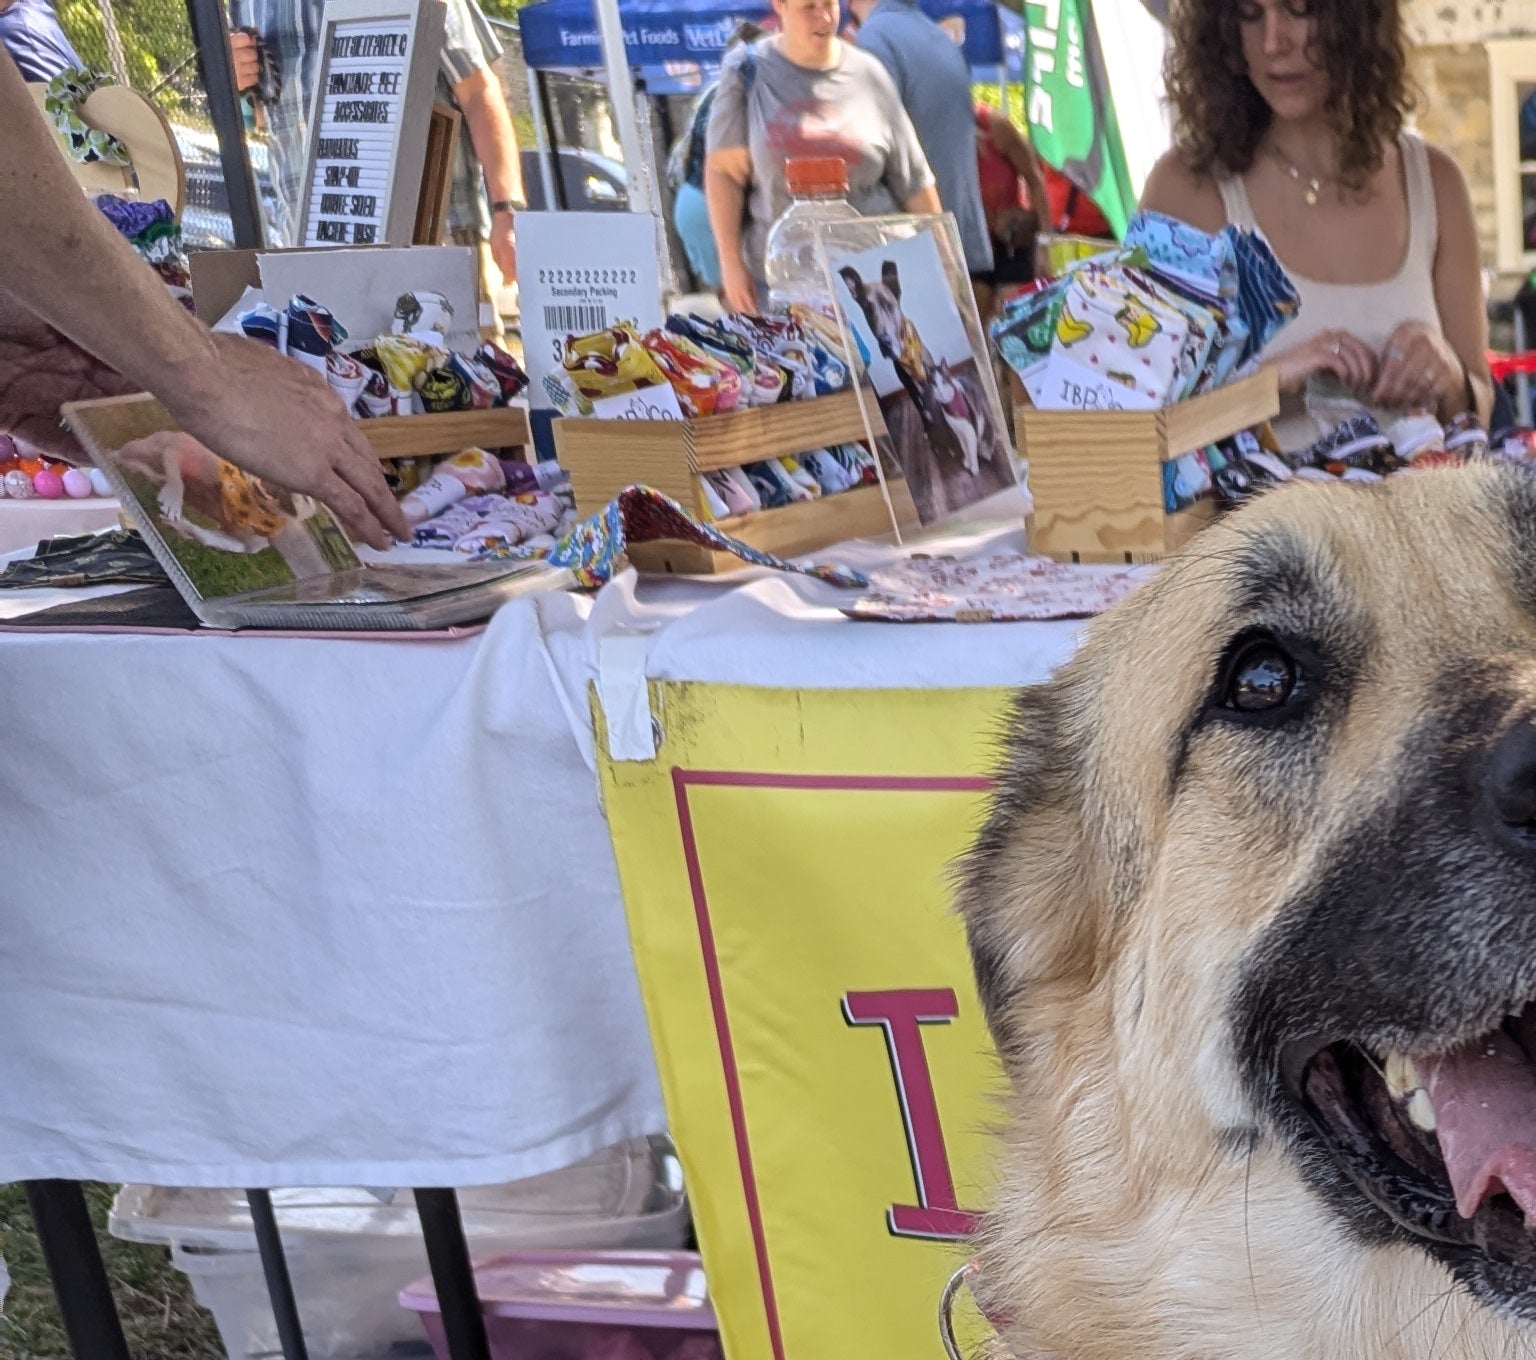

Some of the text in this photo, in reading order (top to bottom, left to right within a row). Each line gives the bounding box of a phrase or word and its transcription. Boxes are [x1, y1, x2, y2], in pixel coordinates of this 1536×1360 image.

[560, 30, 603, 47] Farmi
[640, 28, 680, 46] Foods
[551, 286, 618, 298] Secondary Packing
[1060, 378, 1098, 410] IBP
